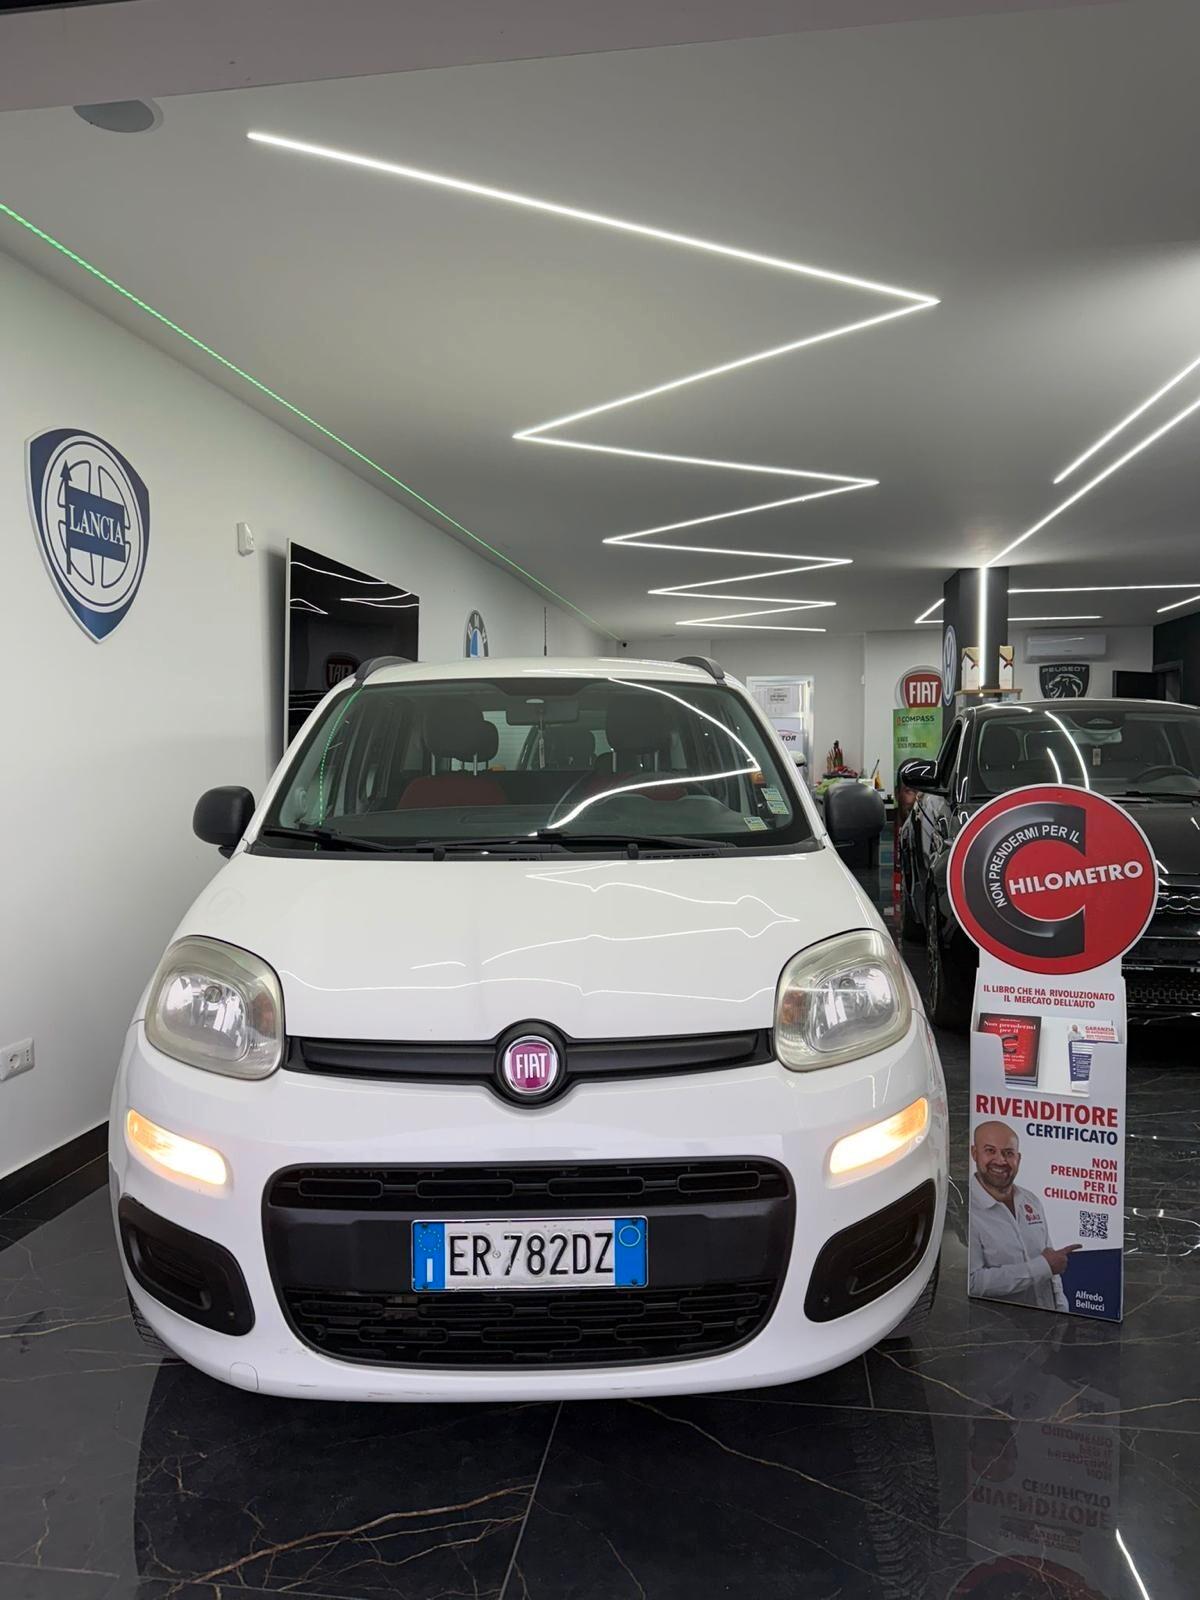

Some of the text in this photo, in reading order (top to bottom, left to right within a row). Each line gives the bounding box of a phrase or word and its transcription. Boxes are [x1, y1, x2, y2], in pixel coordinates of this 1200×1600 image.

[69, 504, 124, 546] LANCIA
[909, 682, 938, 704] FIAT
[902, 715, 935, 723] COMPASS
[989, 825, 1080, 908] NON PRENDERMI PER IL
[992, 985, 1015, 994] LIBRO
[1017, 986, 1032, 995] CHE
[1034, 988, 1046, 996] HA
[1050, 988, 1115, 1000] RIVOLUZIONATO
[1014, 996, 1052, 1006] MERCATO
[1054, 998, 1095, 1008] DELL'AUTO
[516, 1052, 548, 1079] FIAT
[975, 1094, 1118, 1128] RIVENDITORE
[1026, 1123, 1118, 1145] CERTIFICATO
[1092, 1158, 1118, 1170] NON
[1051, 1165, 1118, 1183] PRENDERMI
[1044, 1187, 1117, 1206] CHILOMETRO
[1084, 1181, 1118, 1194] PER IL
[449, 1232, 614, 1277] ER 782DZ
[1076, 1290, 1103, 1302] Alfredo
[1076, 1300, 1104, 1311] Bellucci
